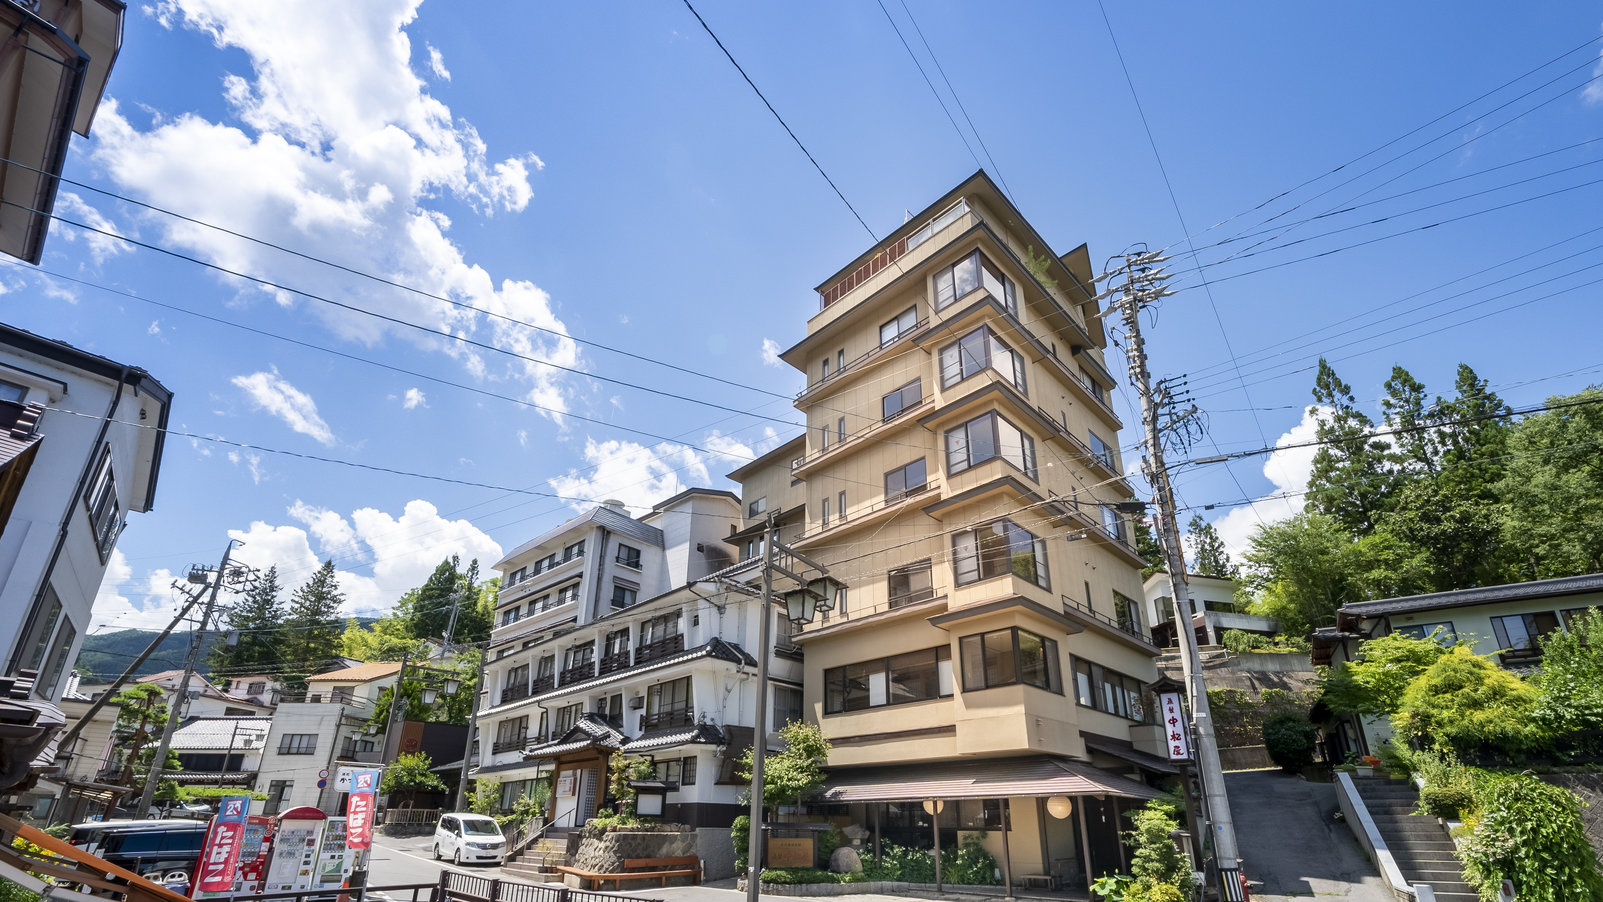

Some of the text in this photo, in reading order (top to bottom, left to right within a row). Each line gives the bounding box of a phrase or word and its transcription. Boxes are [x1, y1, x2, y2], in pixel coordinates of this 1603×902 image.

[1168, 716, 1184, 756] 中松屋
[348, 795, 367, 843] たばこ
[203, 825, 234, 883] たばこ
